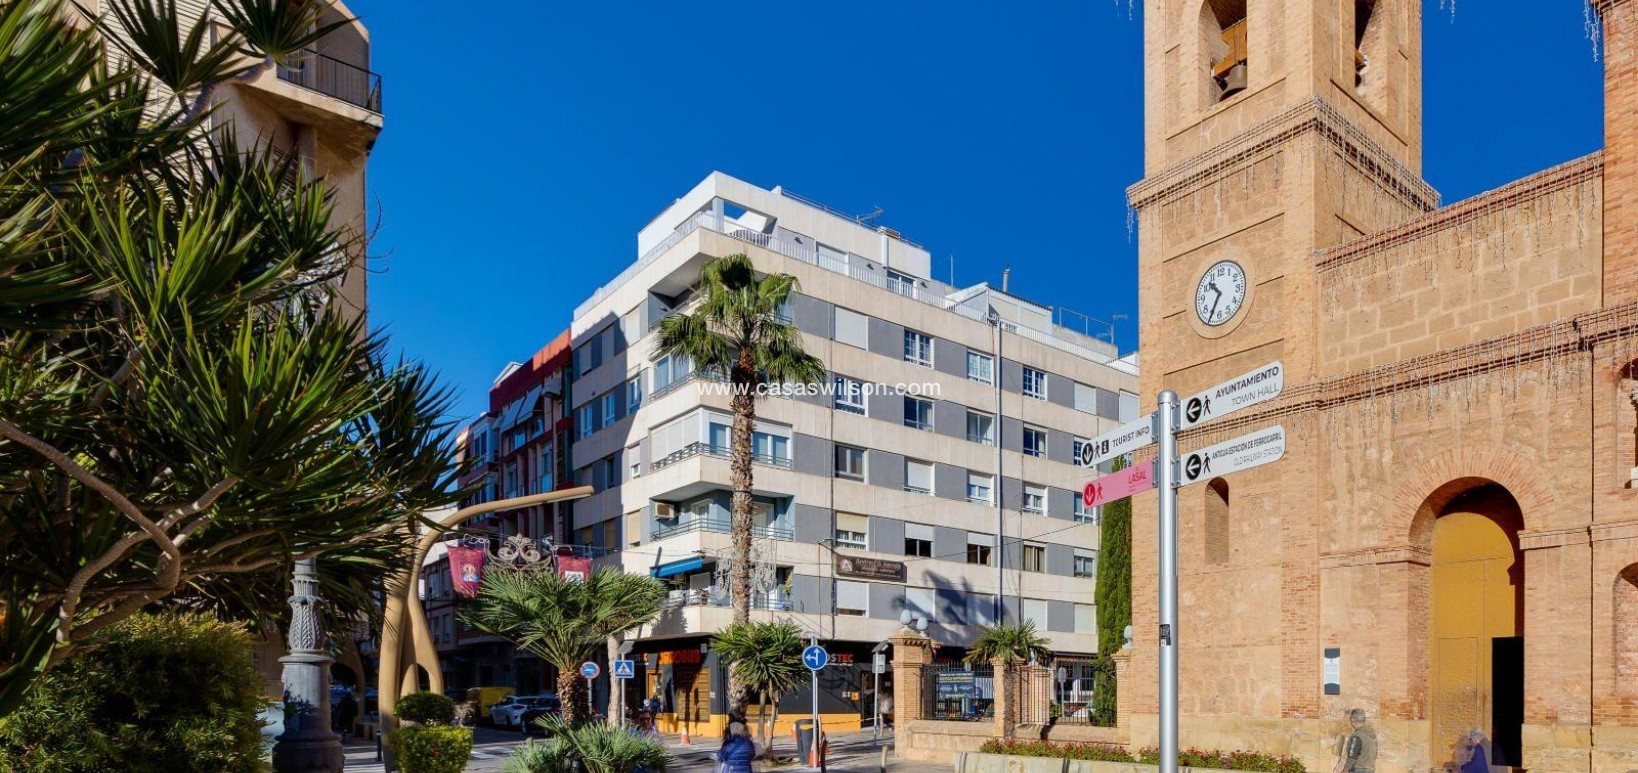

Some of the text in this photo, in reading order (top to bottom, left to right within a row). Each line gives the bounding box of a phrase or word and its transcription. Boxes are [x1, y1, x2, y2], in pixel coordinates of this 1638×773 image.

[1217, 267, 1225, 277] 12
[1215, 366, 1279, 399] AYUNTAMIENTO
[1231, 383, 1279, 407] TOWN HALL
[1112, 425, 1150, 448] TOURIST INFO
[1248, 440, 1253, 449] DE
[1254, 432, 1282, 447] FERROCARRIL
